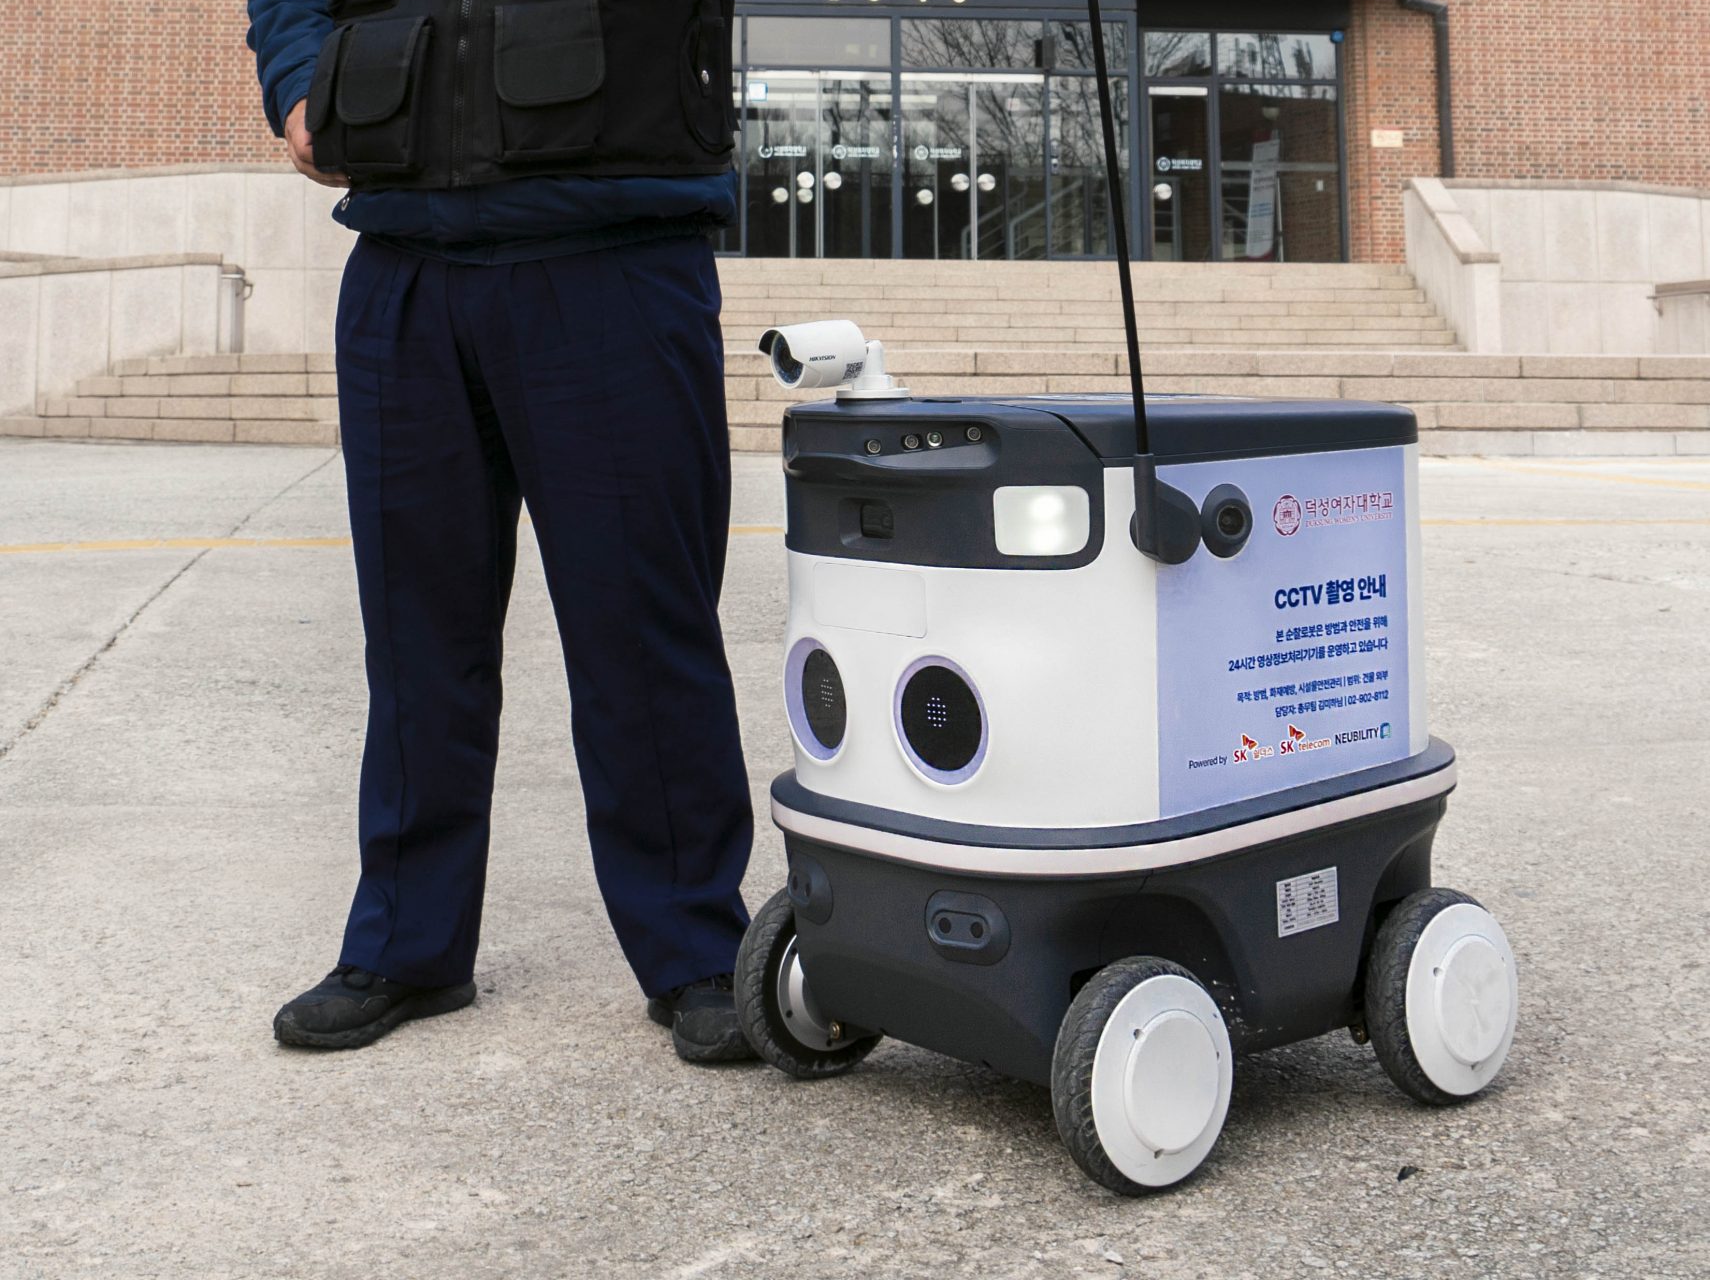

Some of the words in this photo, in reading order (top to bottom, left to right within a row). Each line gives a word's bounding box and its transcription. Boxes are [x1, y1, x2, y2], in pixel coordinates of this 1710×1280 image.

[1305, 492, 1393, 517] 덕성여자대학교
[1274, 584, 1323, 609] CCTV
[1326, 578, 1354, 605] 촬영
[1358, 574, 1387, 601] 안내
[1276, 629, 1284, 643] 본
[1285, 626, 1324, 641] 순찰로봇은
[1324, 621, 1348, 636] 방범과
[1349, 617, 1371, 632] 안전을
[1373, 615, 1388, 629] 위해
[1228, 656, 1256, 672] 24시간
[1257, 646, 1326, 668] 영상정보처리기기를
[1327, 642, 1357, 658] 운영하고
[1358, 637, 1388, 653] 있습니다
[1280, 740, 1294, 754] SK
[1298, 738, 1331, 751] telecom
[1335, 727, 1379, 745] NEUBILITY
[1188, 757, 1218, 769] Powered
[1218, 755, 1228, 766] by
[1233, 749, 1247, 763] SK
